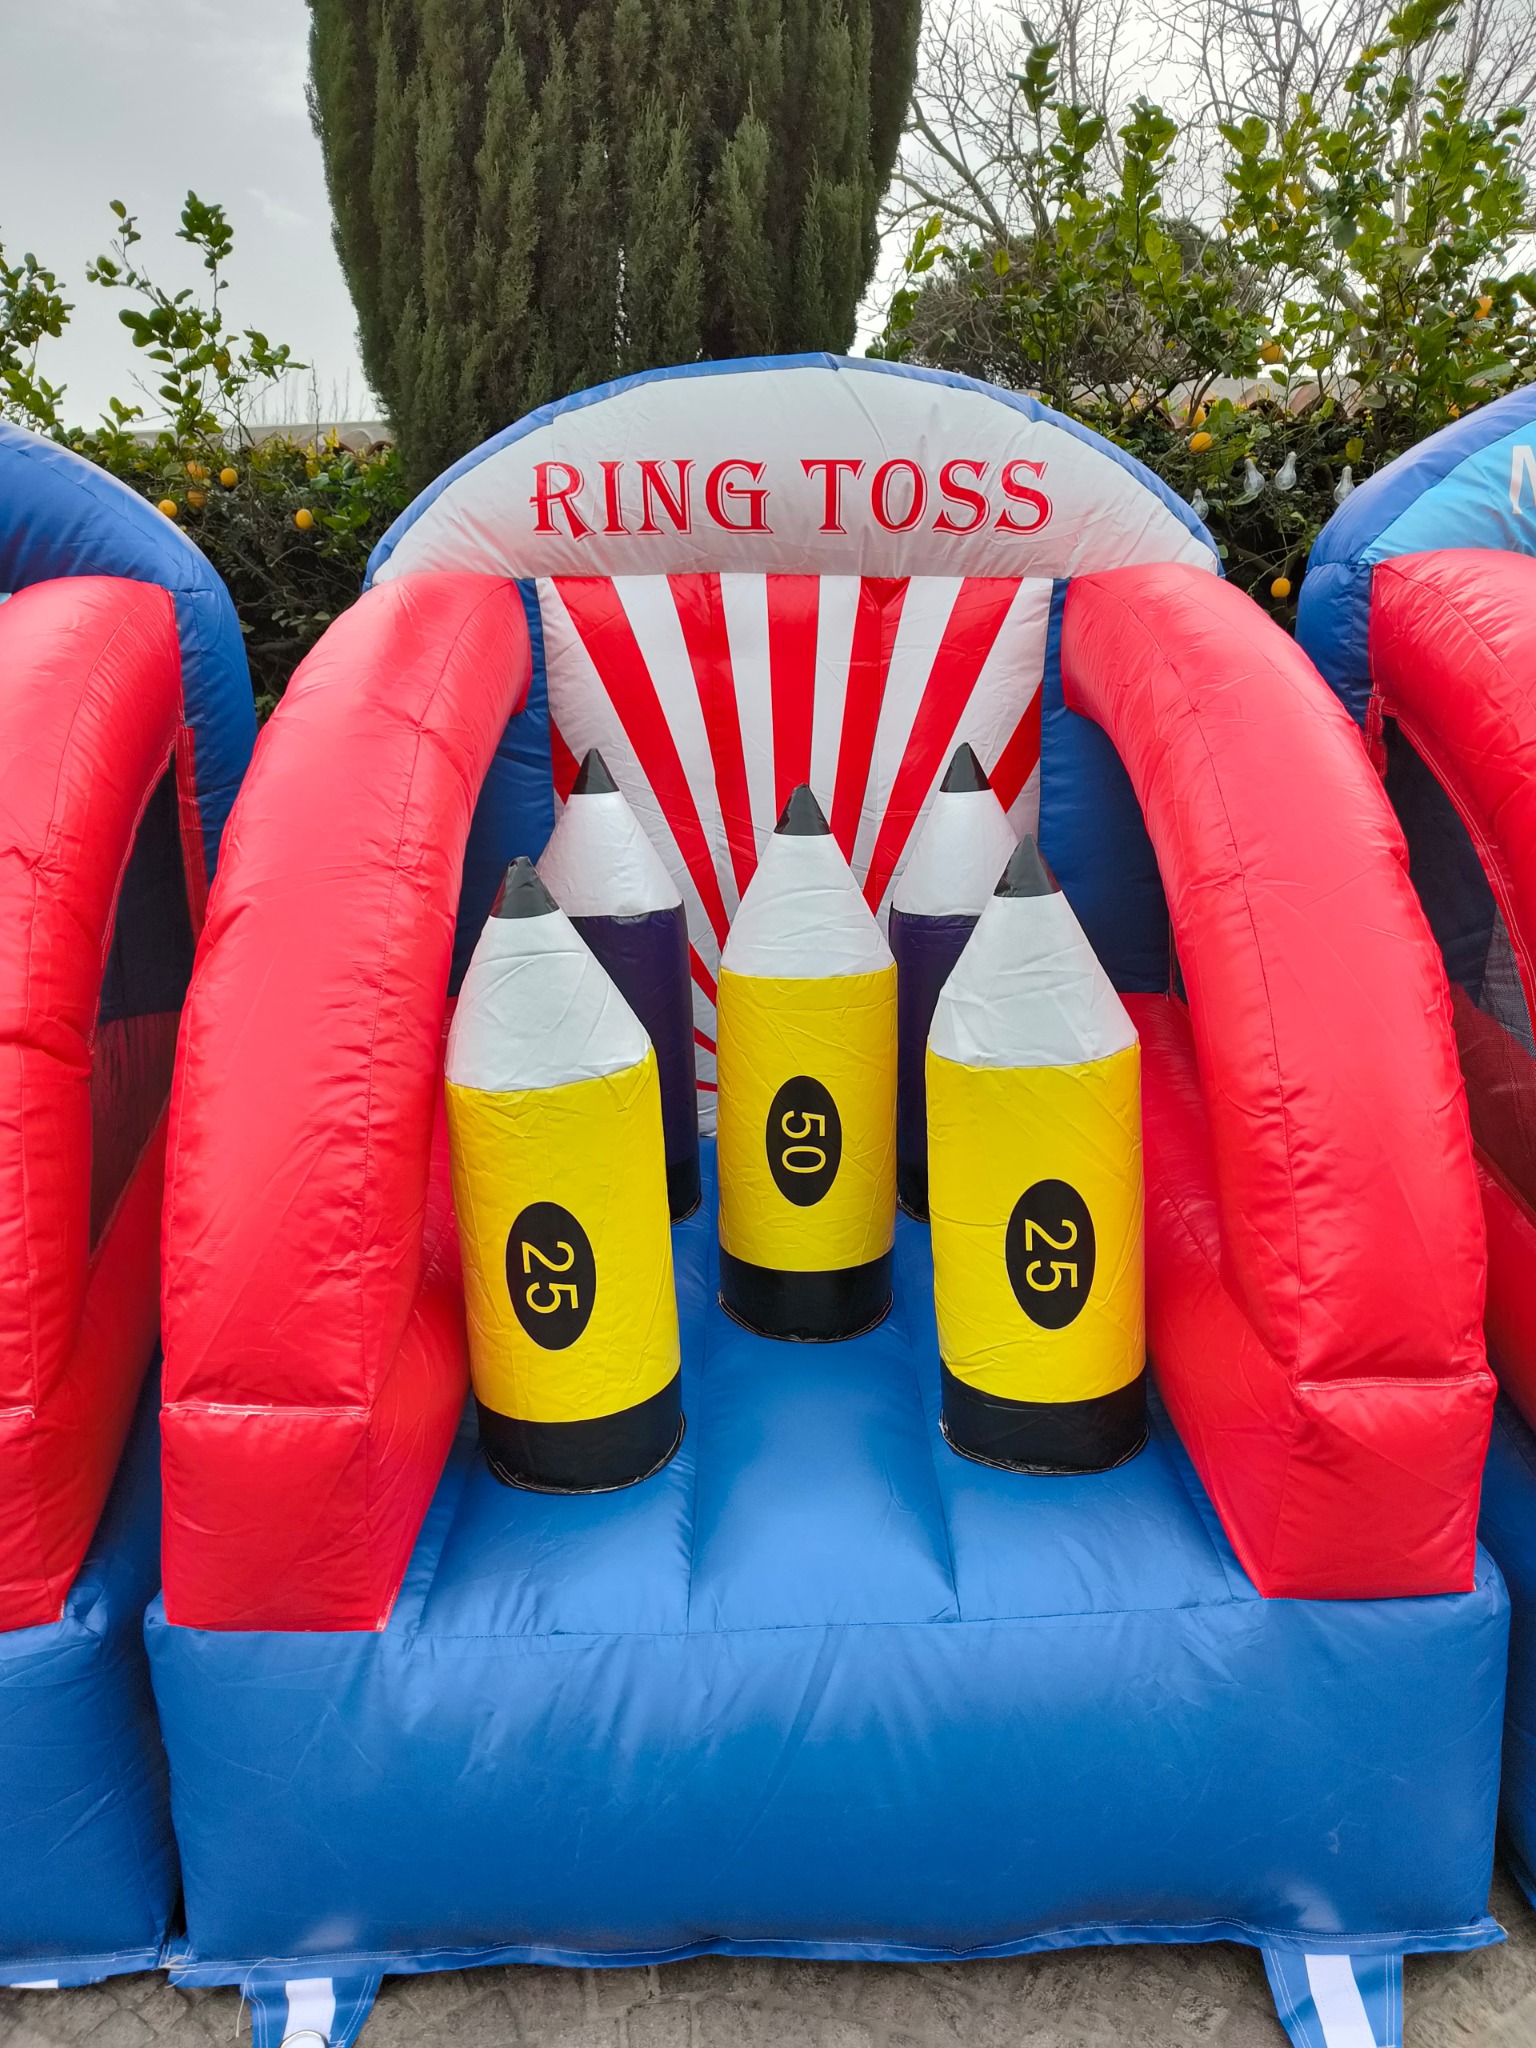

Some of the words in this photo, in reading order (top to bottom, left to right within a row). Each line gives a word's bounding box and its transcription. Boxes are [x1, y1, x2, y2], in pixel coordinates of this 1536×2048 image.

[529, 459, 775, 542] RING
[800, 459, 1053, 535] TOSS
[781, 1110, 827, 1174] 50
[521, 1240, 579, 1315] 25
[1024, 1218, 1079, 1292] 25
